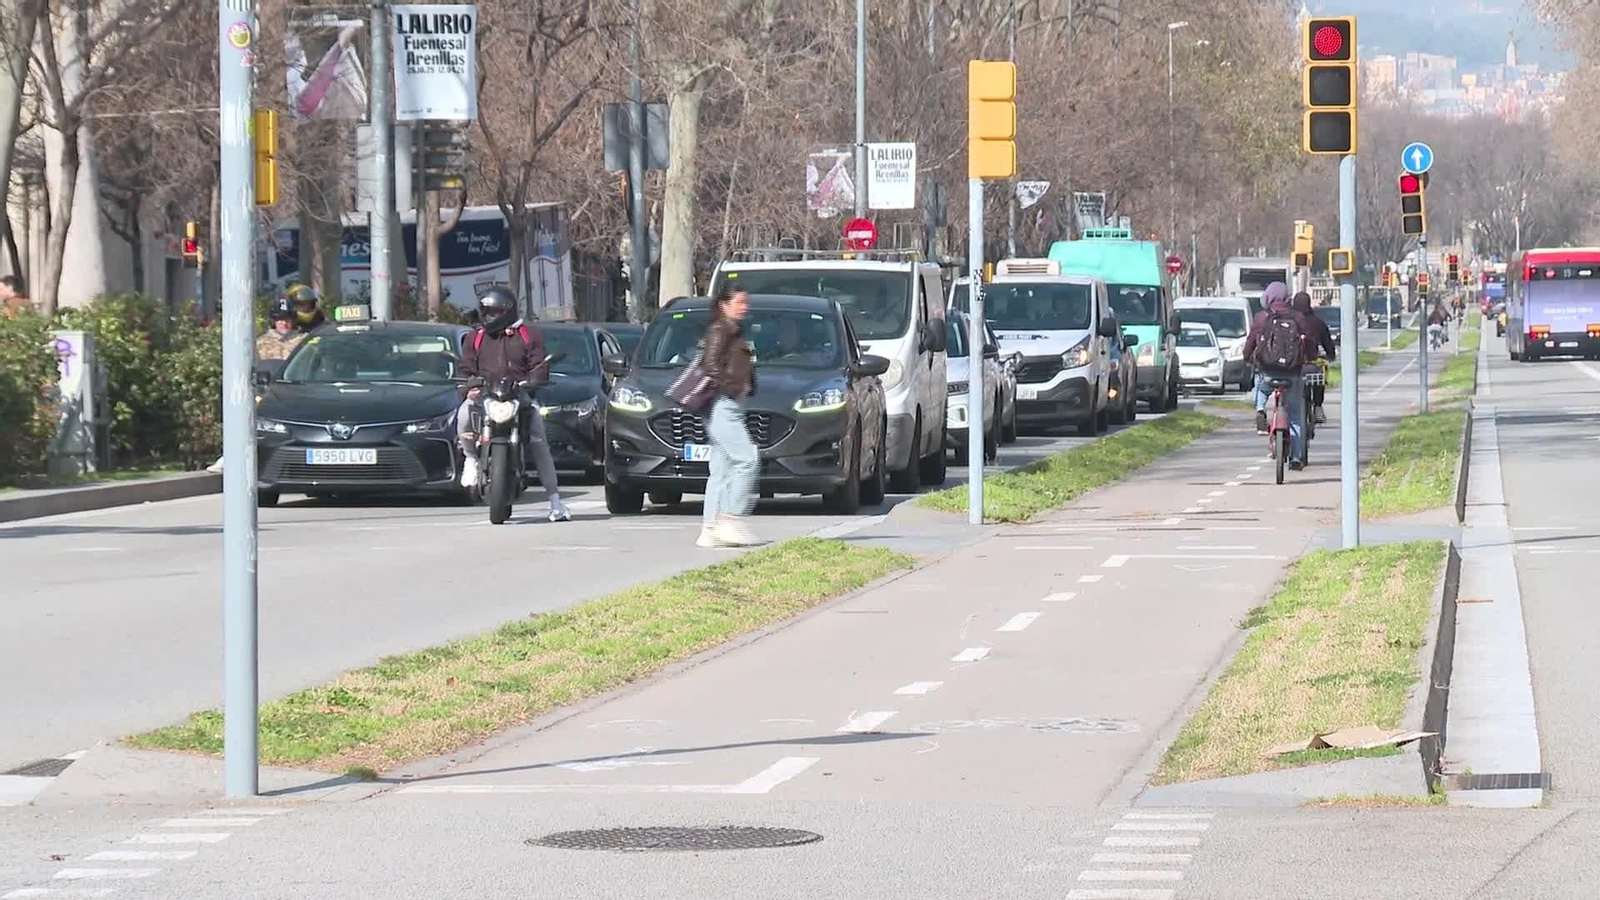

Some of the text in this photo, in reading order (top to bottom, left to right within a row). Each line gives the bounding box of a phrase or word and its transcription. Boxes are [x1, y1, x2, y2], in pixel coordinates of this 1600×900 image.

[396, 13, 472, 34] LALIRIO
[404, 35, 467, 50] Fuentesal
[406, 51, 465, 66] Arenillas
[871, 148, 913, 161] LALIRIO
[341, 307, 361, 319] TAXI
[315, 450, 373, 462] 5950 LVG
